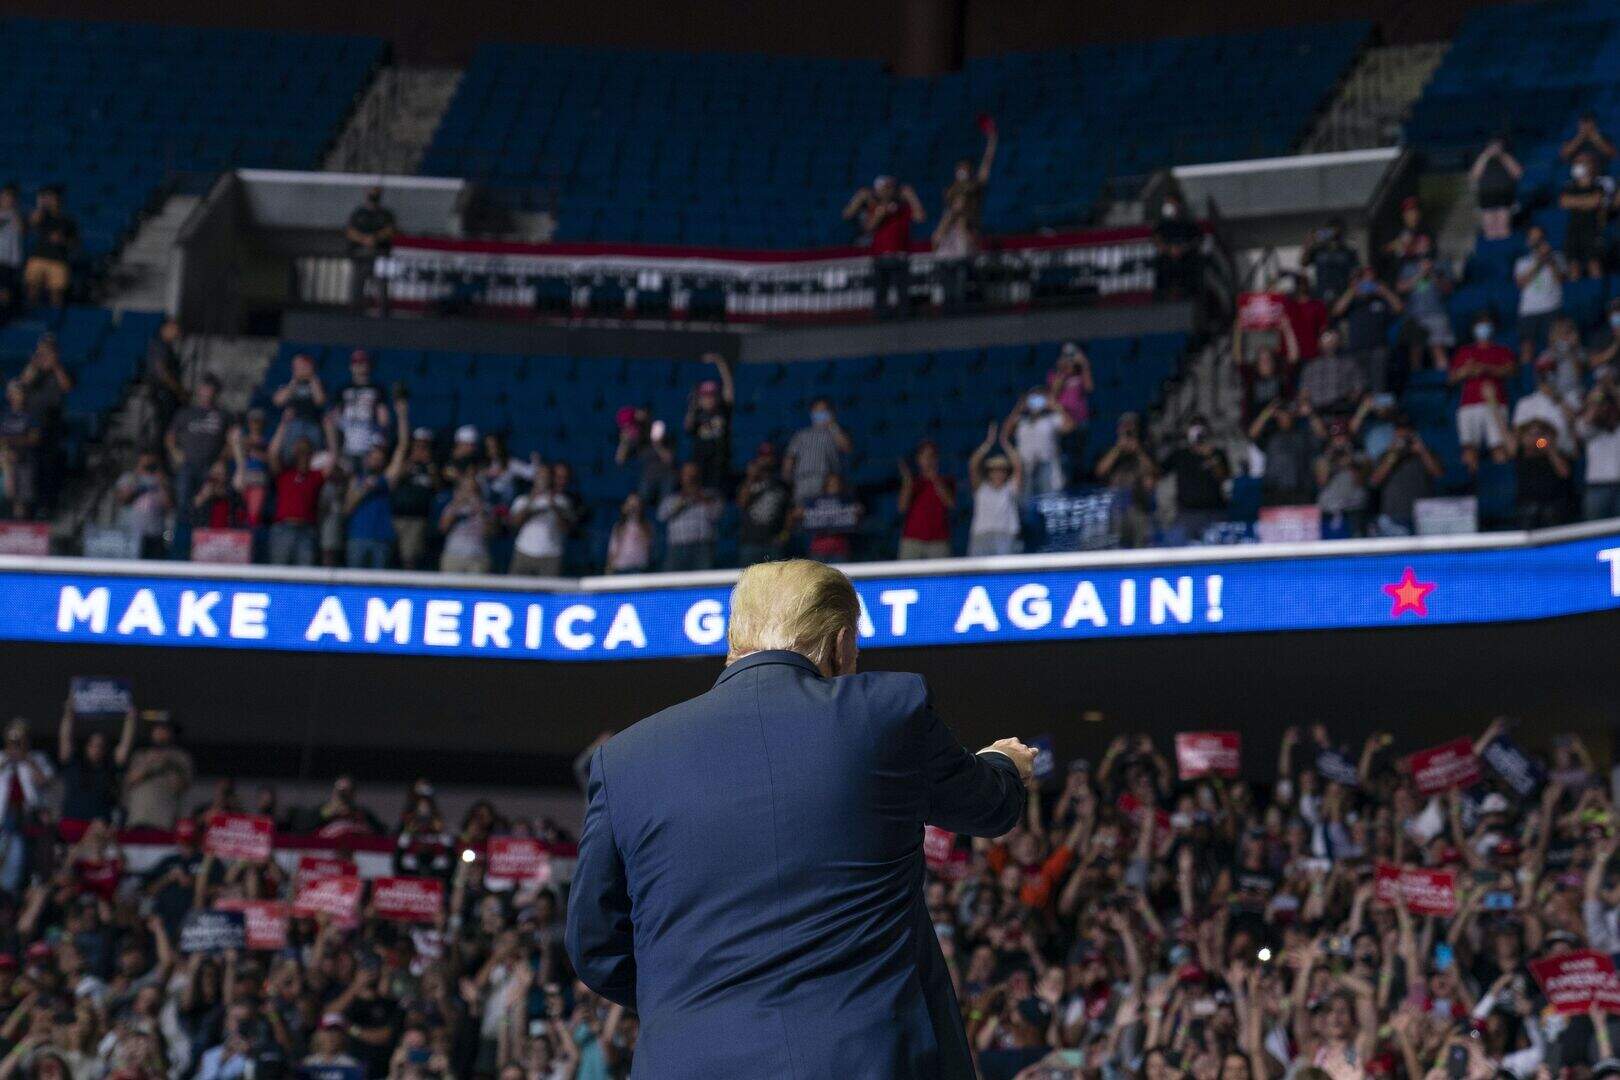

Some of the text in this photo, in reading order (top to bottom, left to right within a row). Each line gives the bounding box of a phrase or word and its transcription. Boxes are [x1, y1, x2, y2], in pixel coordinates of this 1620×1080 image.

[56, 585, 270, 639] MAKE
[305, 596, 646, 650] AMERICA
[954, 575, 1223, 633] AGAIN!
